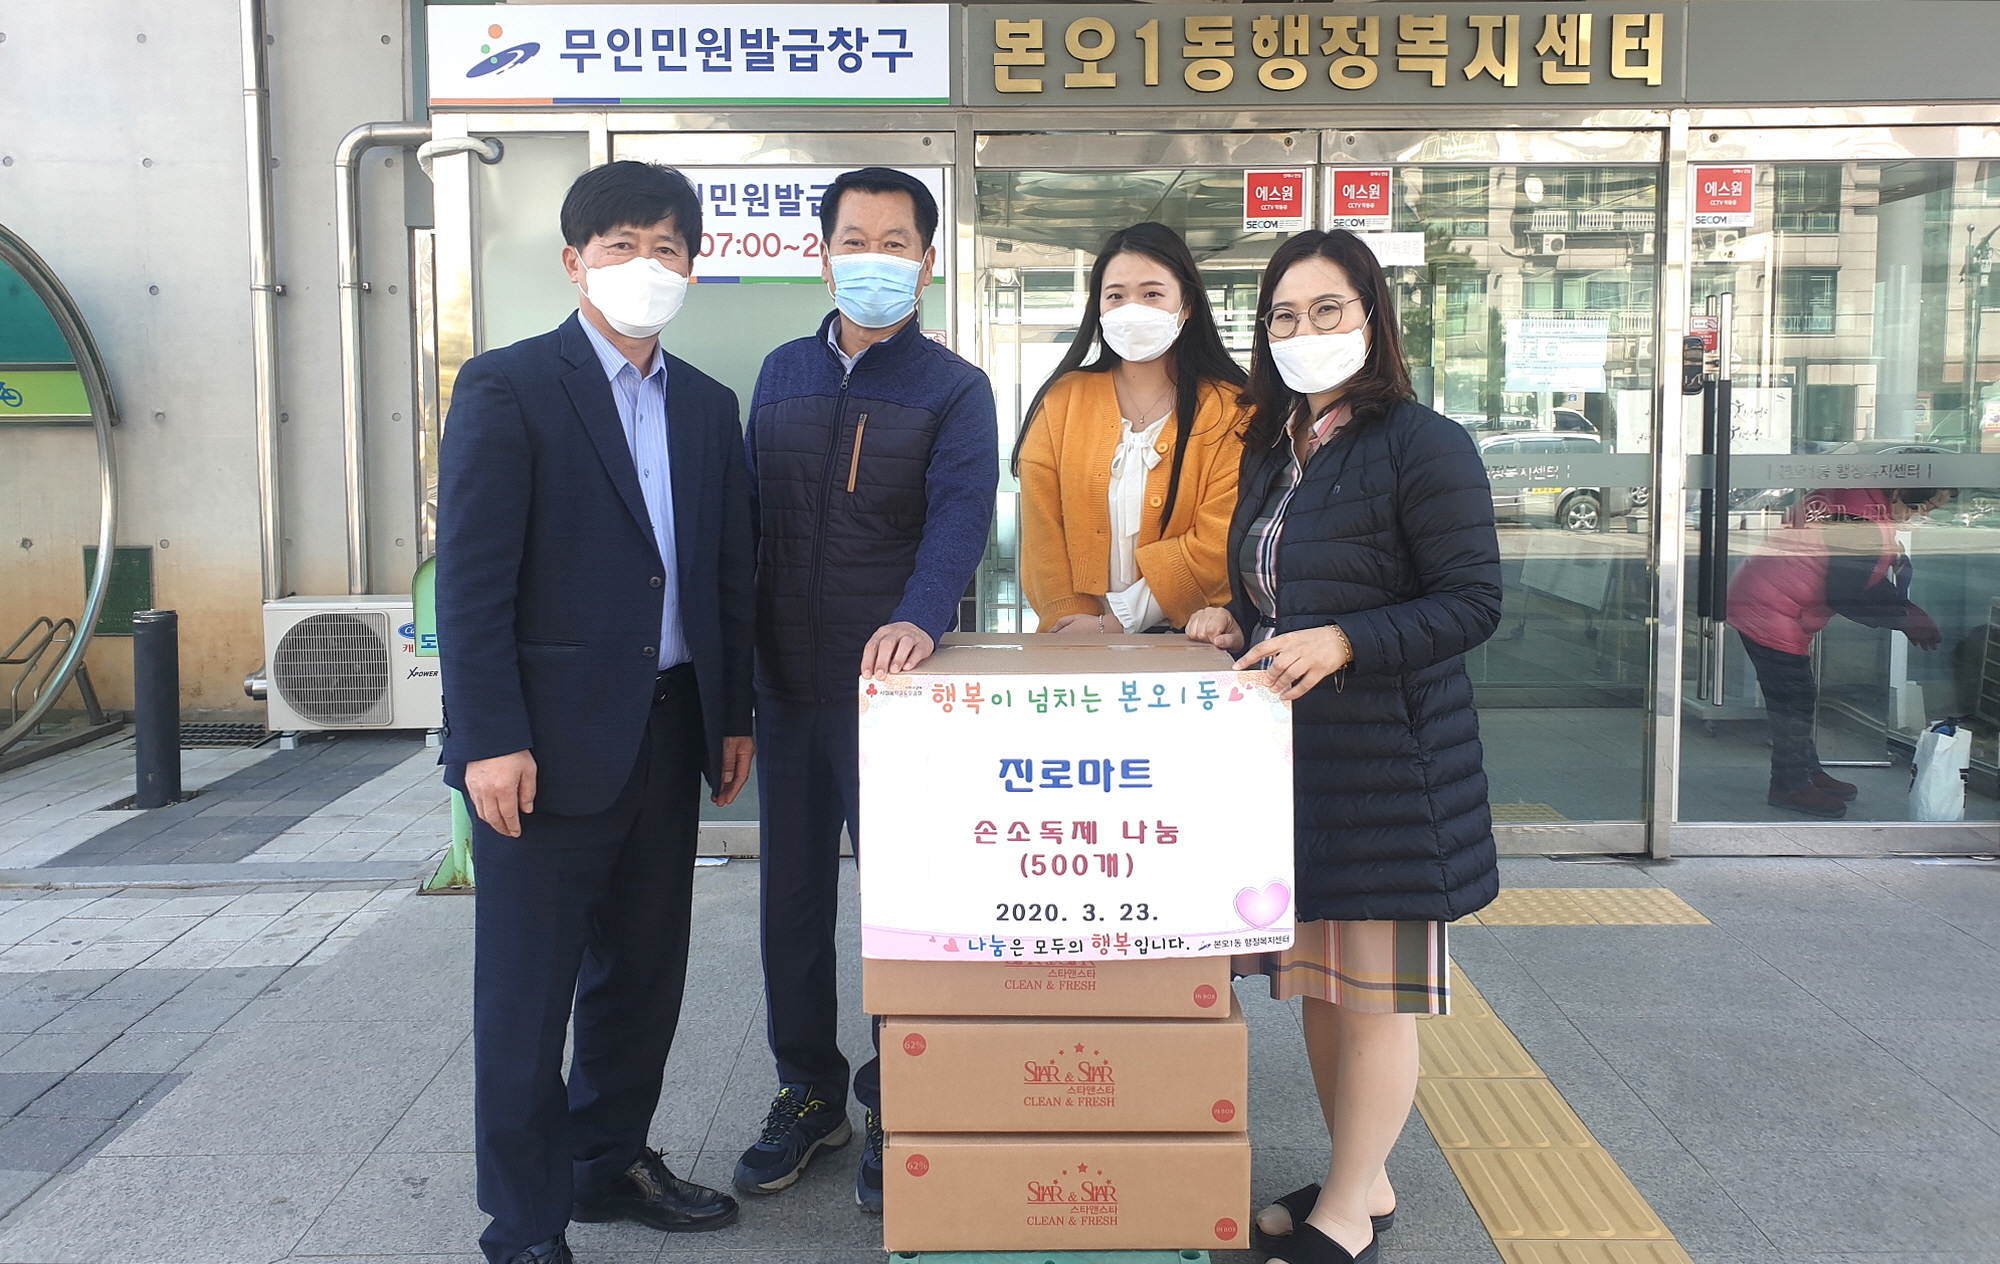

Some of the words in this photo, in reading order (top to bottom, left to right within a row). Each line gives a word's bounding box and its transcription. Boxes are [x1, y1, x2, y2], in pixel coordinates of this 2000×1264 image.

[559, 27, 914, 74] 무인민원발급창구
[993, 13, 1664, 94] 본오1동행정복지센터
[1255, 185, 1294, 201] 에스원
[1342, 183, 1380, 200] 에스원
[1704, 181, 1743, 197] 에스원
[698, 183, 831, 217] 민원발급
[1246, 220, 1279, 229] SECOM
[1333, 218, 1366, 228] SECOM
[1695, 215, 1727, 225] SECOM
[699, 232, 820, 258] 07:00~2
[931, 682, 1012, 714] 행복이
[1028, 686, 1102, 714] 넘치는
[1118, 680, 1220, 712] 본오1동
[999, 758, 1153, 793] 진로마트
[973, 820, 1097, 845] 손소독제
[1121, 820, 1179, 844] 나눔
[1019, 853, 1134, 878] (500개)
[996, 903, 1067, 922] 2020.
[1082, 903, 1105, 922] 3.
[1120, 903, 1159, 922] 23.
[967, 935, 1024, 958] 나눔은
[1033, 937, 1084, 956] 모두의
[1091, 932, 1190, 956] 행복입니다.
[1213, 939, 1241, 950] 본오1동
[1244, 935, 1290, 948] 행정복지센터
[1048, 969, 1096, 979] 스타앤스타
[1004, 979, 1043, 991] CLEAN
[1046, 979, 1055, 990] &
[1058, 979, 1097, 991] FRESH
[1195, 992, 1203, 1000] IN
[1203, 992, 1216, 1000] BOX
[904, 1039, 926, 1050] 62%
[1064, 1071, 1074, 1082] &
[1067, 1085, 1115, 1096] 스타앤스타
[1023, 1096, 1062, 1107] CLEAN
[1065, 1096, 1074, 1107] &
[1077, 1097, 1116, 1108] FRESH
[1213, 1107, 1221, 1115] IN
[1221, 1107, 1234, 1115] BOX
[907, 1160, 928, 1171] 62%
[1067, 1191, 1078, 1202] &
[1070, 1205, 1118, 1215] 스타앤스타
[1026, 1216, 1065, 1227] CLEAN
[1068, 1216, 1078, 1227] &
[1080, 1216, 1119, 1227] FRESH
[1216, 1225, 1224, 1233] IN
[1224, 1225, 1237, 1233] BOX
